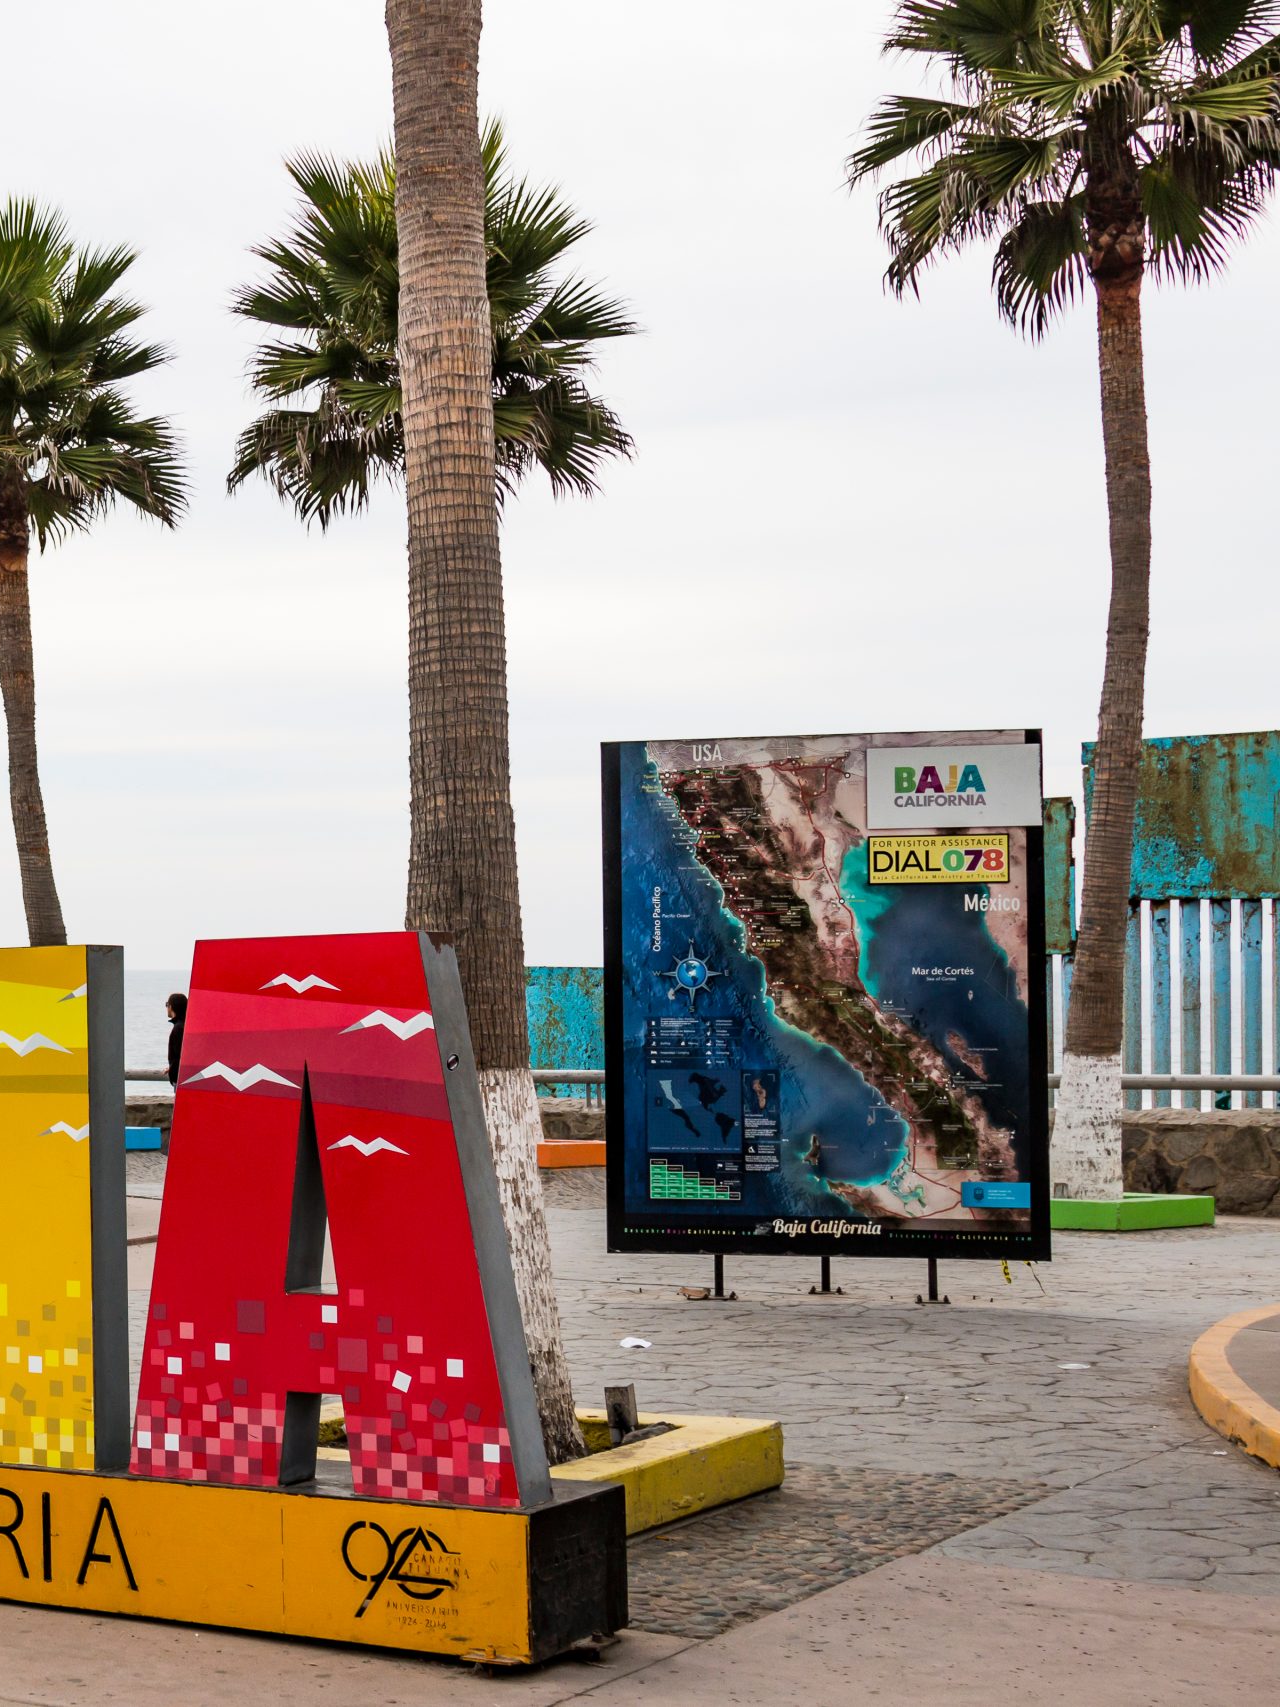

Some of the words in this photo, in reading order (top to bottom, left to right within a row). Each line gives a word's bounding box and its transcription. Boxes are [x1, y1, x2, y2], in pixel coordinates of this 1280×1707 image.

[692, 743, 723, 761] USA
[894, 764, 986, 794] BAJA
[894, 794, 986, 808] CALIFORNIA
[872, 840, 892, 848] FOR
[897, 839, 936, 847] VISITOR
[941, 838, 1004, 847] ASSISTANCE
[873, 850, 941, 873] DIAL
[942, 848, 1005, 872] 078
[964, 893, 1021, 912] México
[652, 920, 661, 952] Océano
[911, 967, 929, 976] Mar
[931, 967, 943, 975] de
[944, 966, 975, 976] Cortés
[772, 1218, 807, 1238] Baja
[810, 1218, 882, 1239] California
[408, 1562, 470, 1580] TIJUANA
